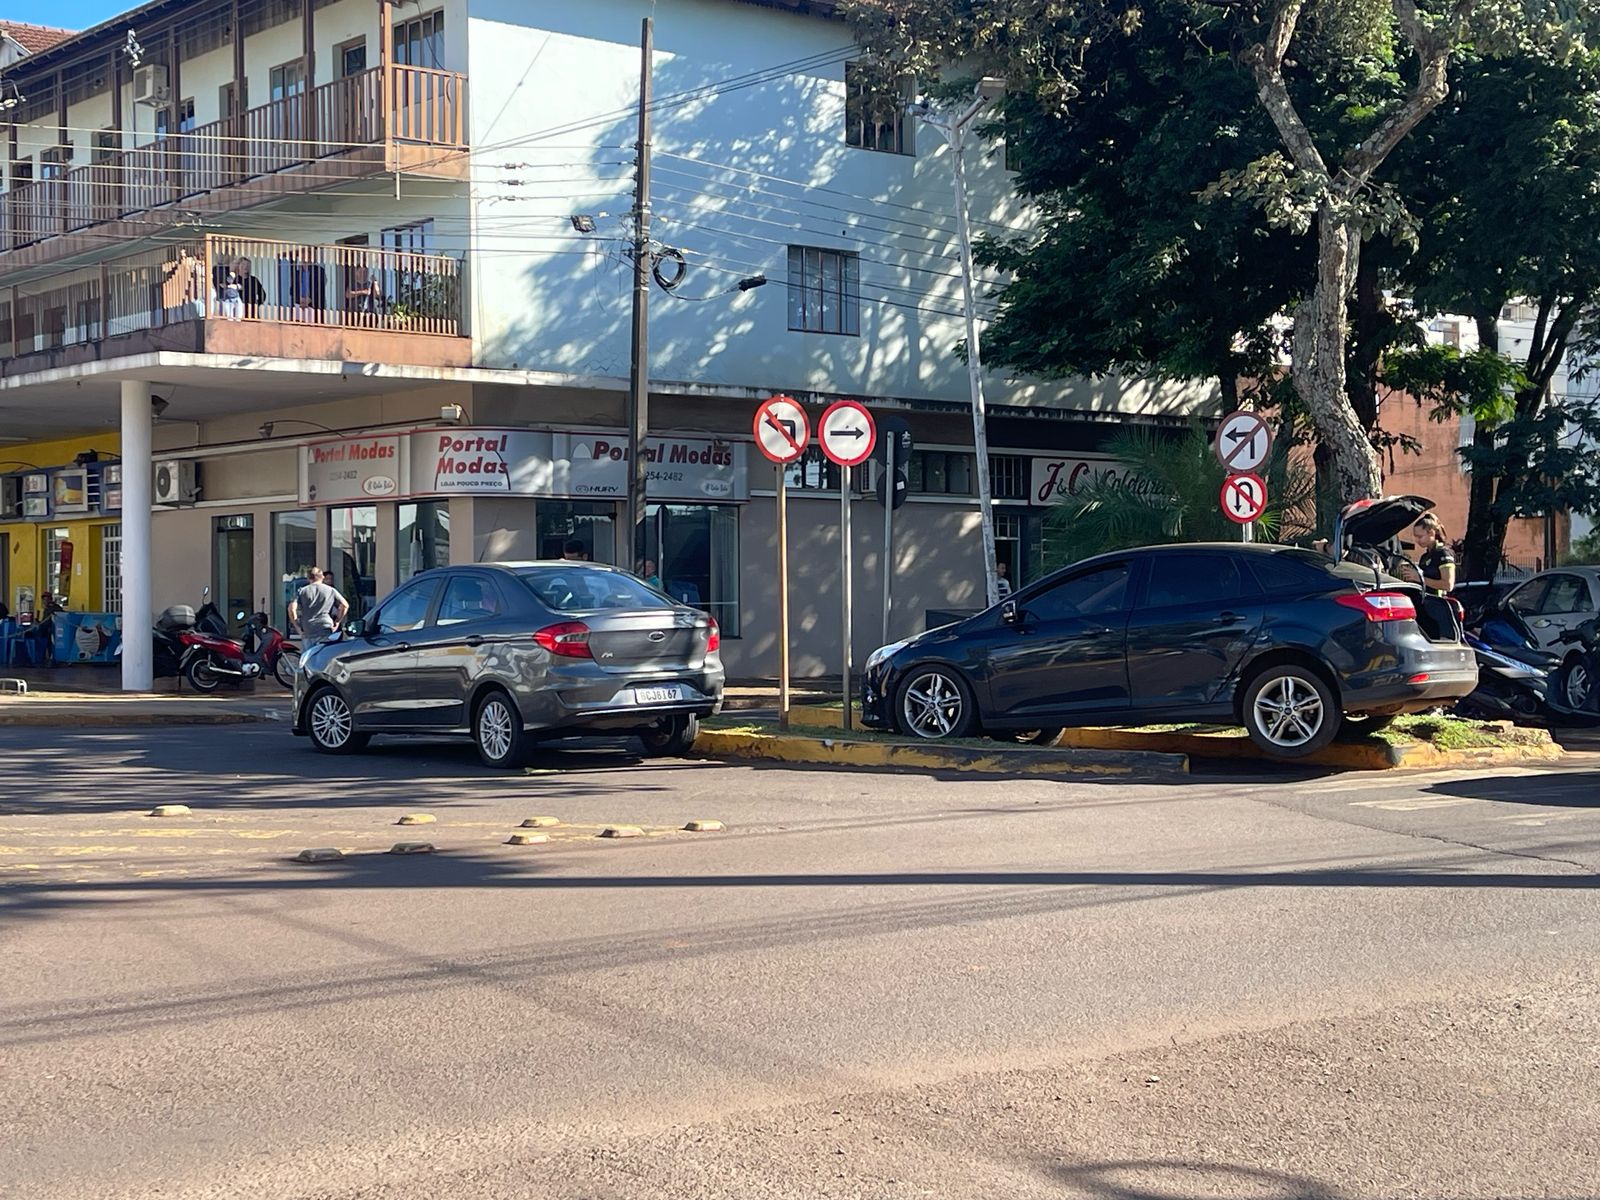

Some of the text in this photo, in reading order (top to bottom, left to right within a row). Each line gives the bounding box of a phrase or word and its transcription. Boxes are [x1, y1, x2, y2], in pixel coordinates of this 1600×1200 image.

[314, 441, 395, 463] Portal Modas
[438, 434, 508, 453] Portal
[592, 440, 732, 466] Poal Modas
[437, 456, 508, 474] Modas
